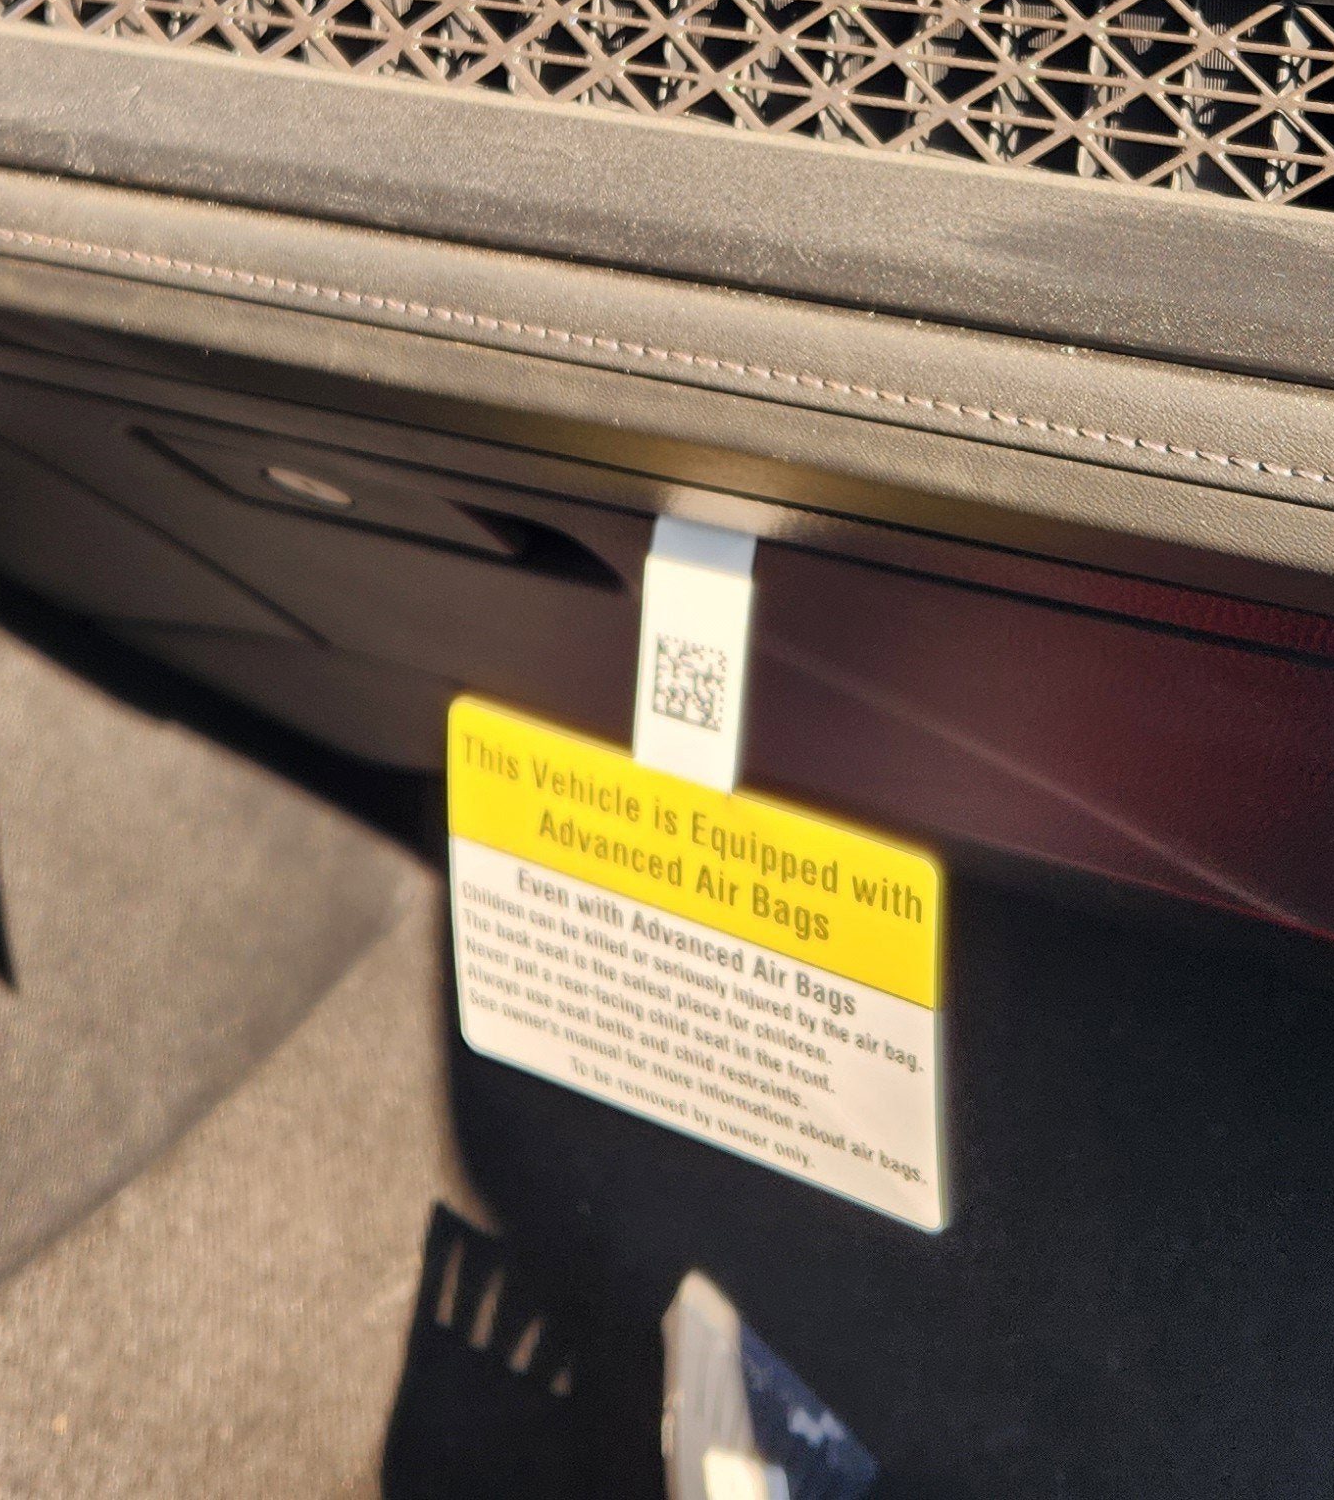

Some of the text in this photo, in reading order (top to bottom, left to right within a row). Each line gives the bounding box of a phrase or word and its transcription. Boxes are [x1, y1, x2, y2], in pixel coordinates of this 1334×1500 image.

[460, 734, 923, 924] This Vehicle is Equipped with
[538, 807, 830, 941] Advanced Air Bags
[462, 880, 925, 1073] Children can be killed or seriously injured by the air bag.
[463, 907, 833, 1066] The back seat is the safest place for children.
[465, 936, 509, 966] Never
[513, 956, 539, 980] put
[556, 971, 645, 1022] rear-facing
[649, 1007, 690, 1036] child
[693, 1024, 731, 1051] seat
[733, 1040, 752, 1060] in
[754, 1047, 783, 1073] the
[785, 1060, 836, 1095] front.
[517, 867, 857, 1016] Even with Advanced Air Bags
[467, 961, 808, 1110] Always use seat belts and child restraints.
[468, 986, 499, 1012] See
[564, 1025, 623, 1059] manual
[626, 1049, 647, 1070] for
[650, 1061, 693, 1090] more
[698, 1078, 793, 1130] information
[797, 1119, 848, 1152] about
[850, 1139, 874, 1161] air
[569, 1054, 589, 1077] To
[593, 1065, 613, 1086] be
[617, 1077, 688, 1117] removed
[691, 1104, 713, 1128] by
[717, 1117, 768, 1150] owner
